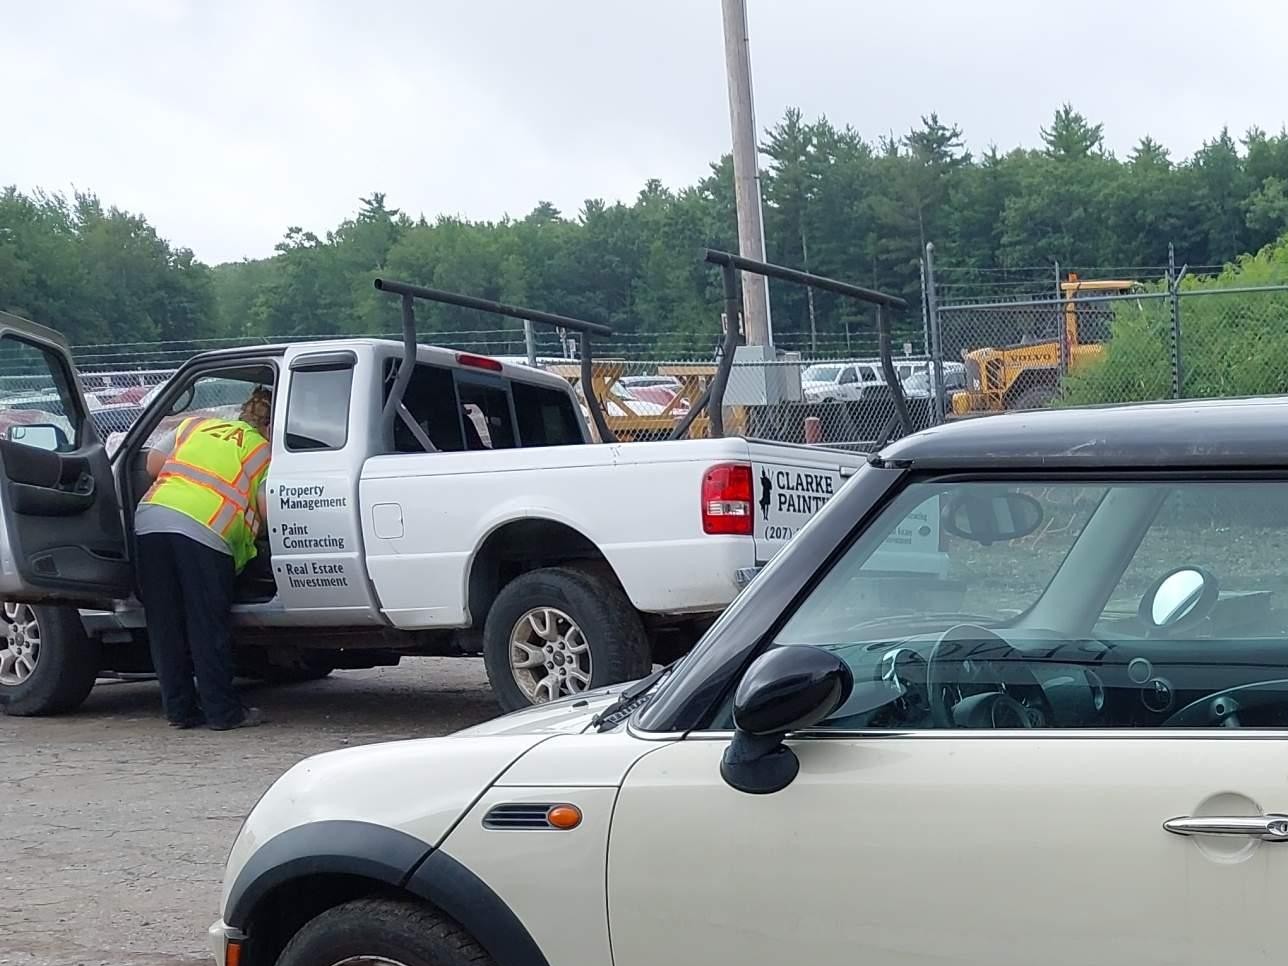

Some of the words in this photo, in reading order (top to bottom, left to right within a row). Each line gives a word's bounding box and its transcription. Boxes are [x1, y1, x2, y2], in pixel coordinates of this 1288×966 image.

[1010, 354, 1051, 362] VOLVO
[776, 471, 834, 494] CLARKE
[279, 485, 324, 498] Property
[280, 497, 347, 510] Management
[777, 492, 831, 514] PAINT
[281, 523, 309, 536] Paint
[764, 526, 793, 541] (207)
[283, 535, 345, 549] Contracting
[286, 562, 309, 575] Real
[312, 562, 344, 574] Estate
[289, 576, 348, 588] Investment
